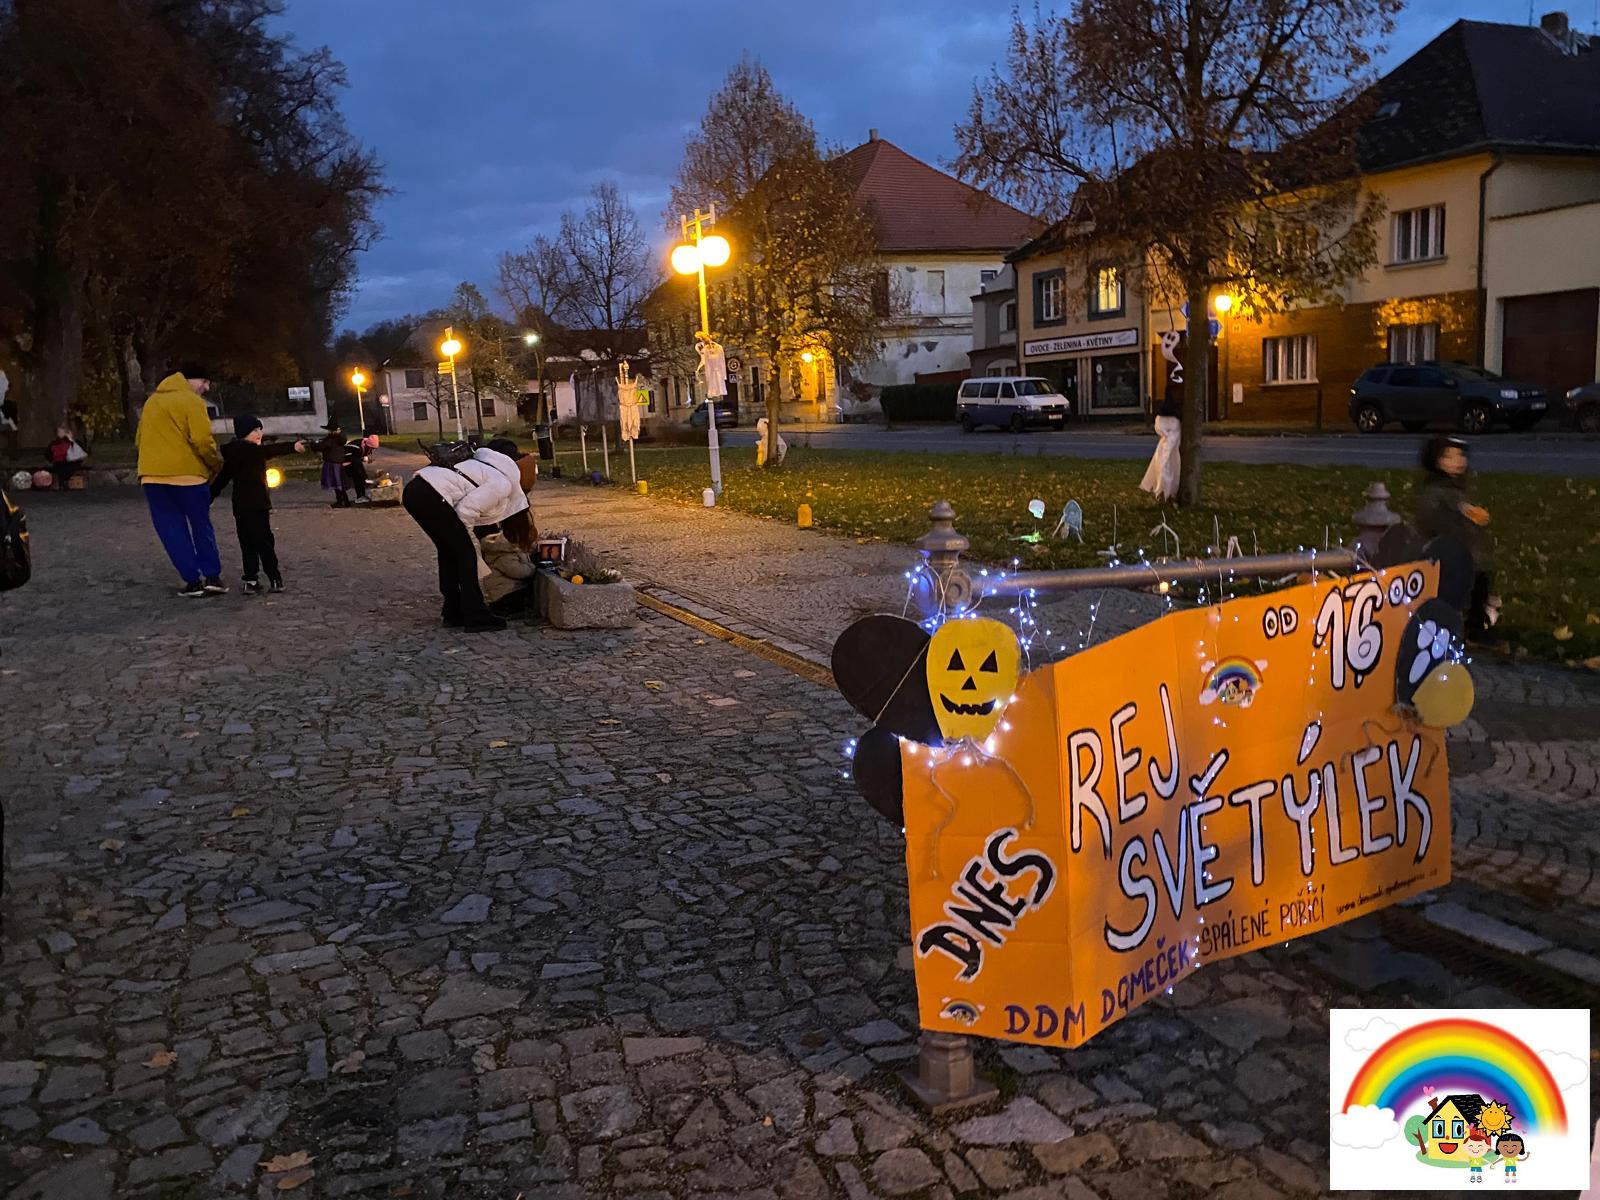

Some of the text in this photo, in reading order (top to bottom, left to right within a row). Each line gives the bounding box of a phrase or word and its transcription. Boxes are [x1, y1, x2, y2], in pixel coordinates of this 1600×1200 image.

[1030, 343, 1049, 353] OVOCE
[1053, 340, 1082, 351] ZELENINA
[1262, 604, 1299, 640] OD
[1067, 683, 1180, 861] REJ
[1104, 722, 1434, 953] SVĚTÝLEK
[917, 827, 1057, 982] DNES
[1003, 1001, 1086, 1042] DDM
[1101, 935, 1191, 1024] DOMEČEK
[1201, 897, 1272, 957] SPÁLENÉ
[1279, 883, 1326, 933] POŘÍČÍ
